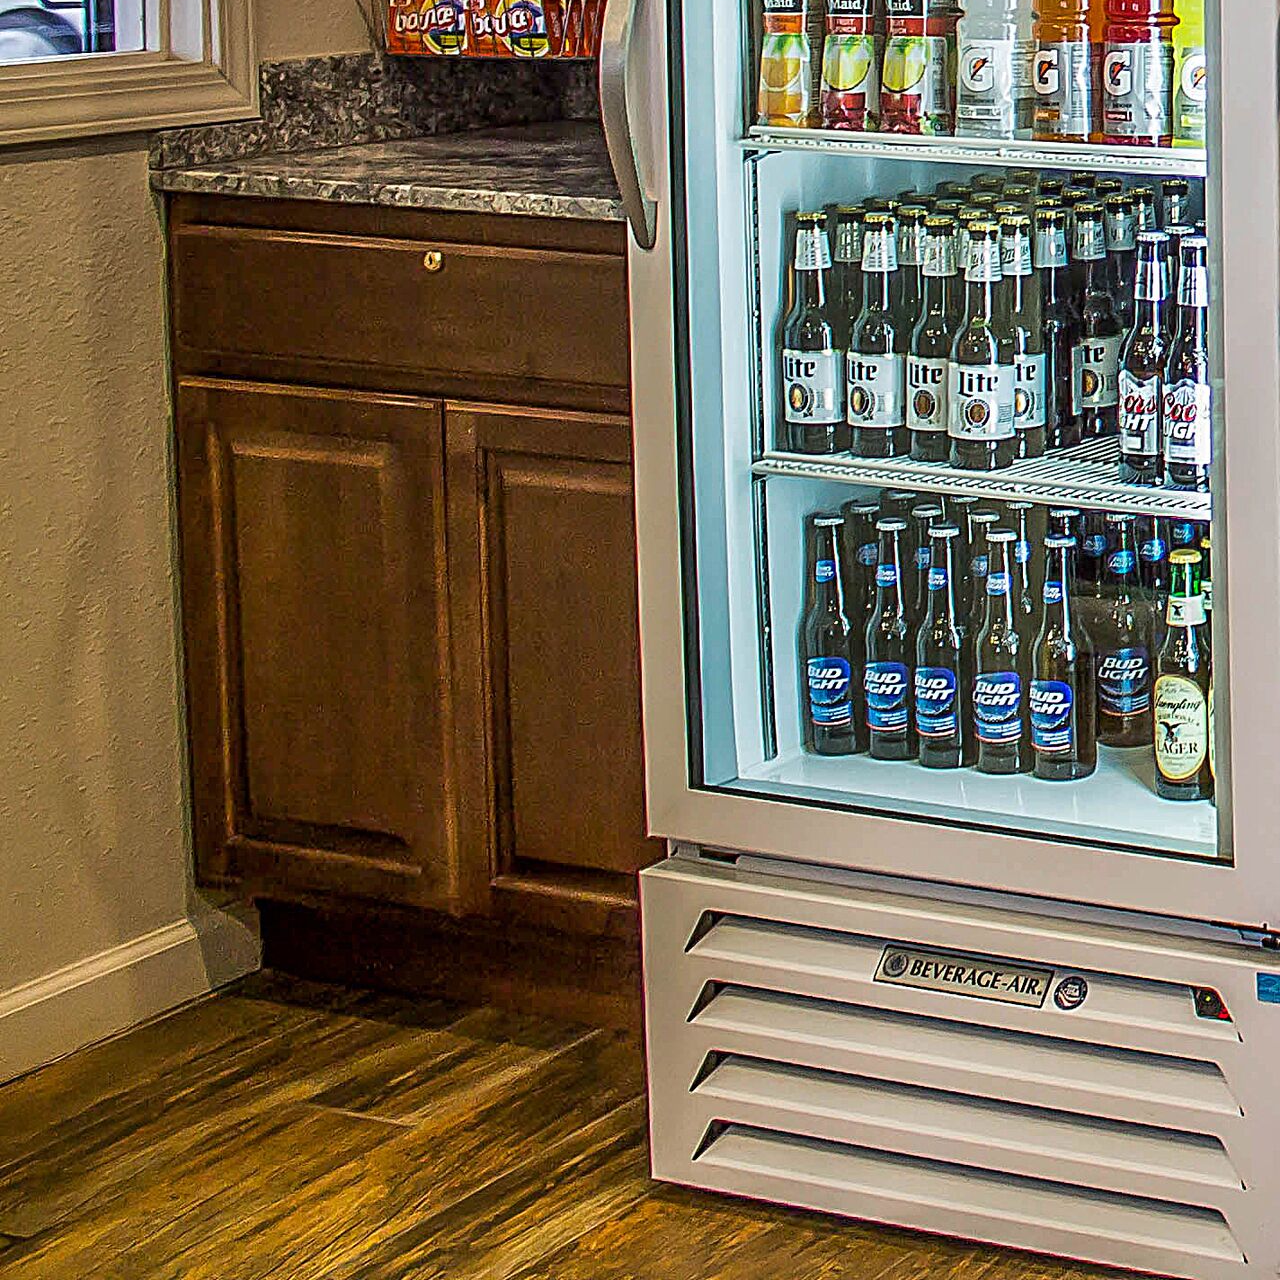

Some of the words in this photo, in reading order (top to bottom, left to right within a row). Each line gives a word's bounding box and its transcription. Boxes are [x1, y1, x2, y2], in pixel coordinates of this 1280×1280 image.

[396, 6, 456, 32] bounce
[472, 8, 529, 36] bounce
[1104, 50, 1132, 97] G
[784, 356, 816, 381] Lite
[909, 362, 943, 387] Lite
[958, 371, 998, 397] Lite
[1099, 666, 1149, 681] LIGHT
[1103, 657, 1143, 669] BUD
[975, 681, 1016, 694] BUD
[1157, 741, 1199, 755] LAGER
